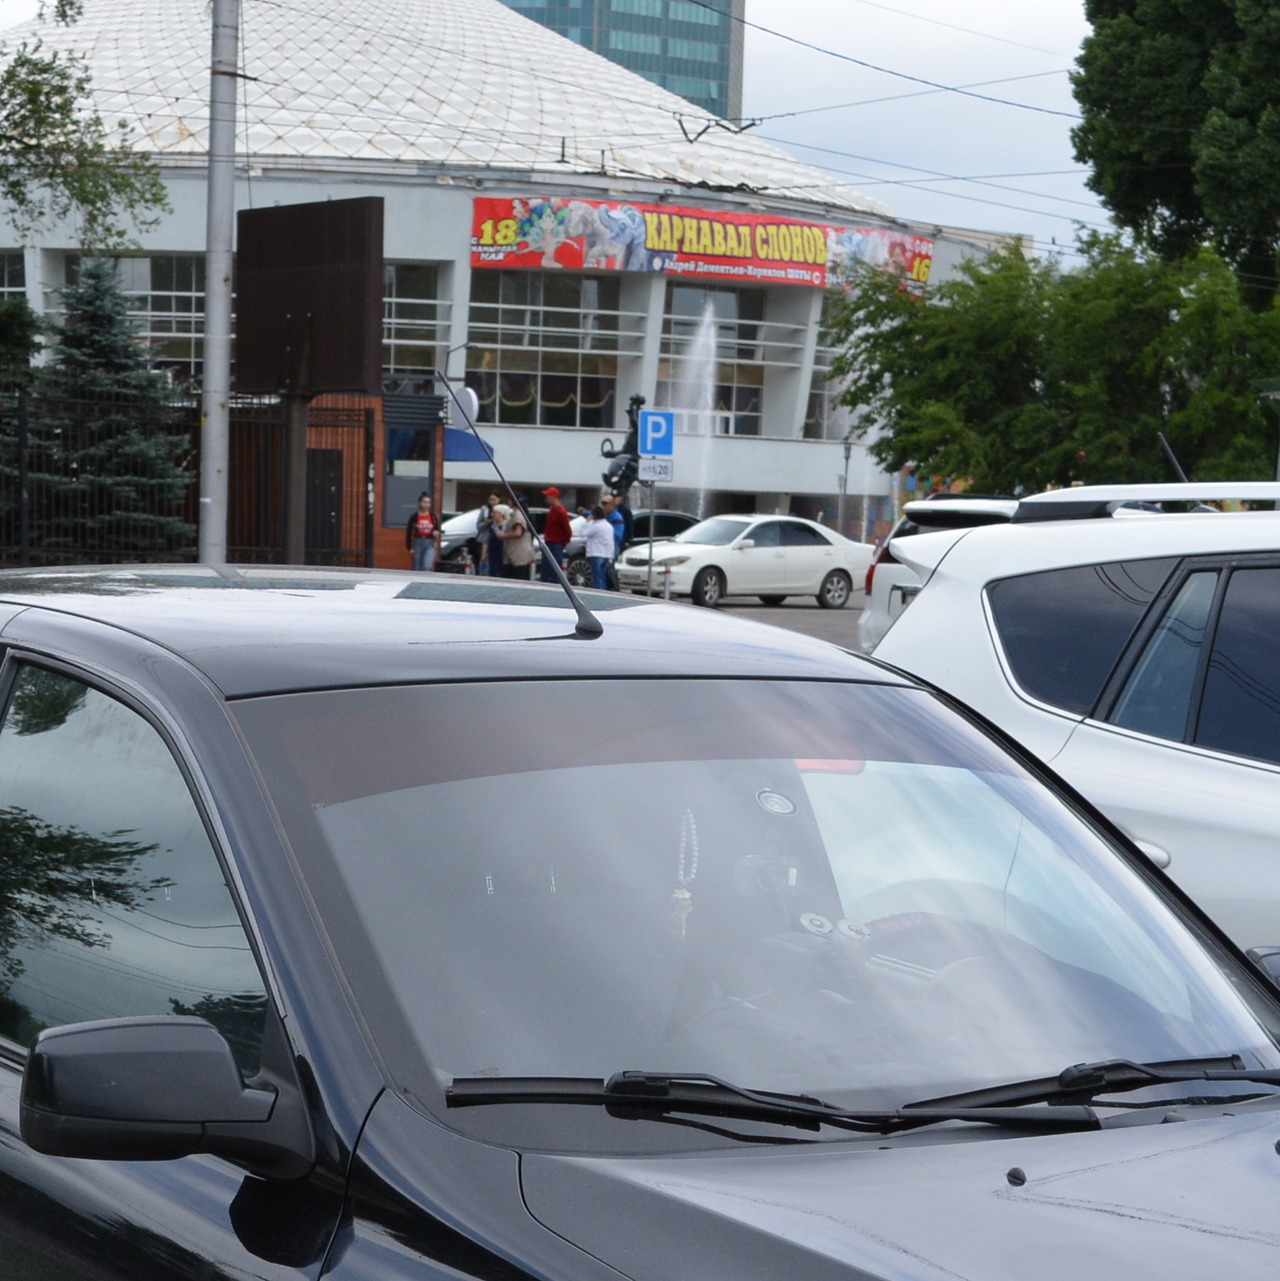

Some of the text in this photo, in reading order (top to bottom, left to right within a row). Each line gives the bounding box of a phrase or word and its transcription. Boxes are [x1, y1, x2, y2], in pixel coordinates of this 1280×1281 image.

[479, 219, 518, 245] 18
[643, 212, 827, 264] КАРНАВАЛ СЛОНОВ
[646, 415, 667, 451] P
